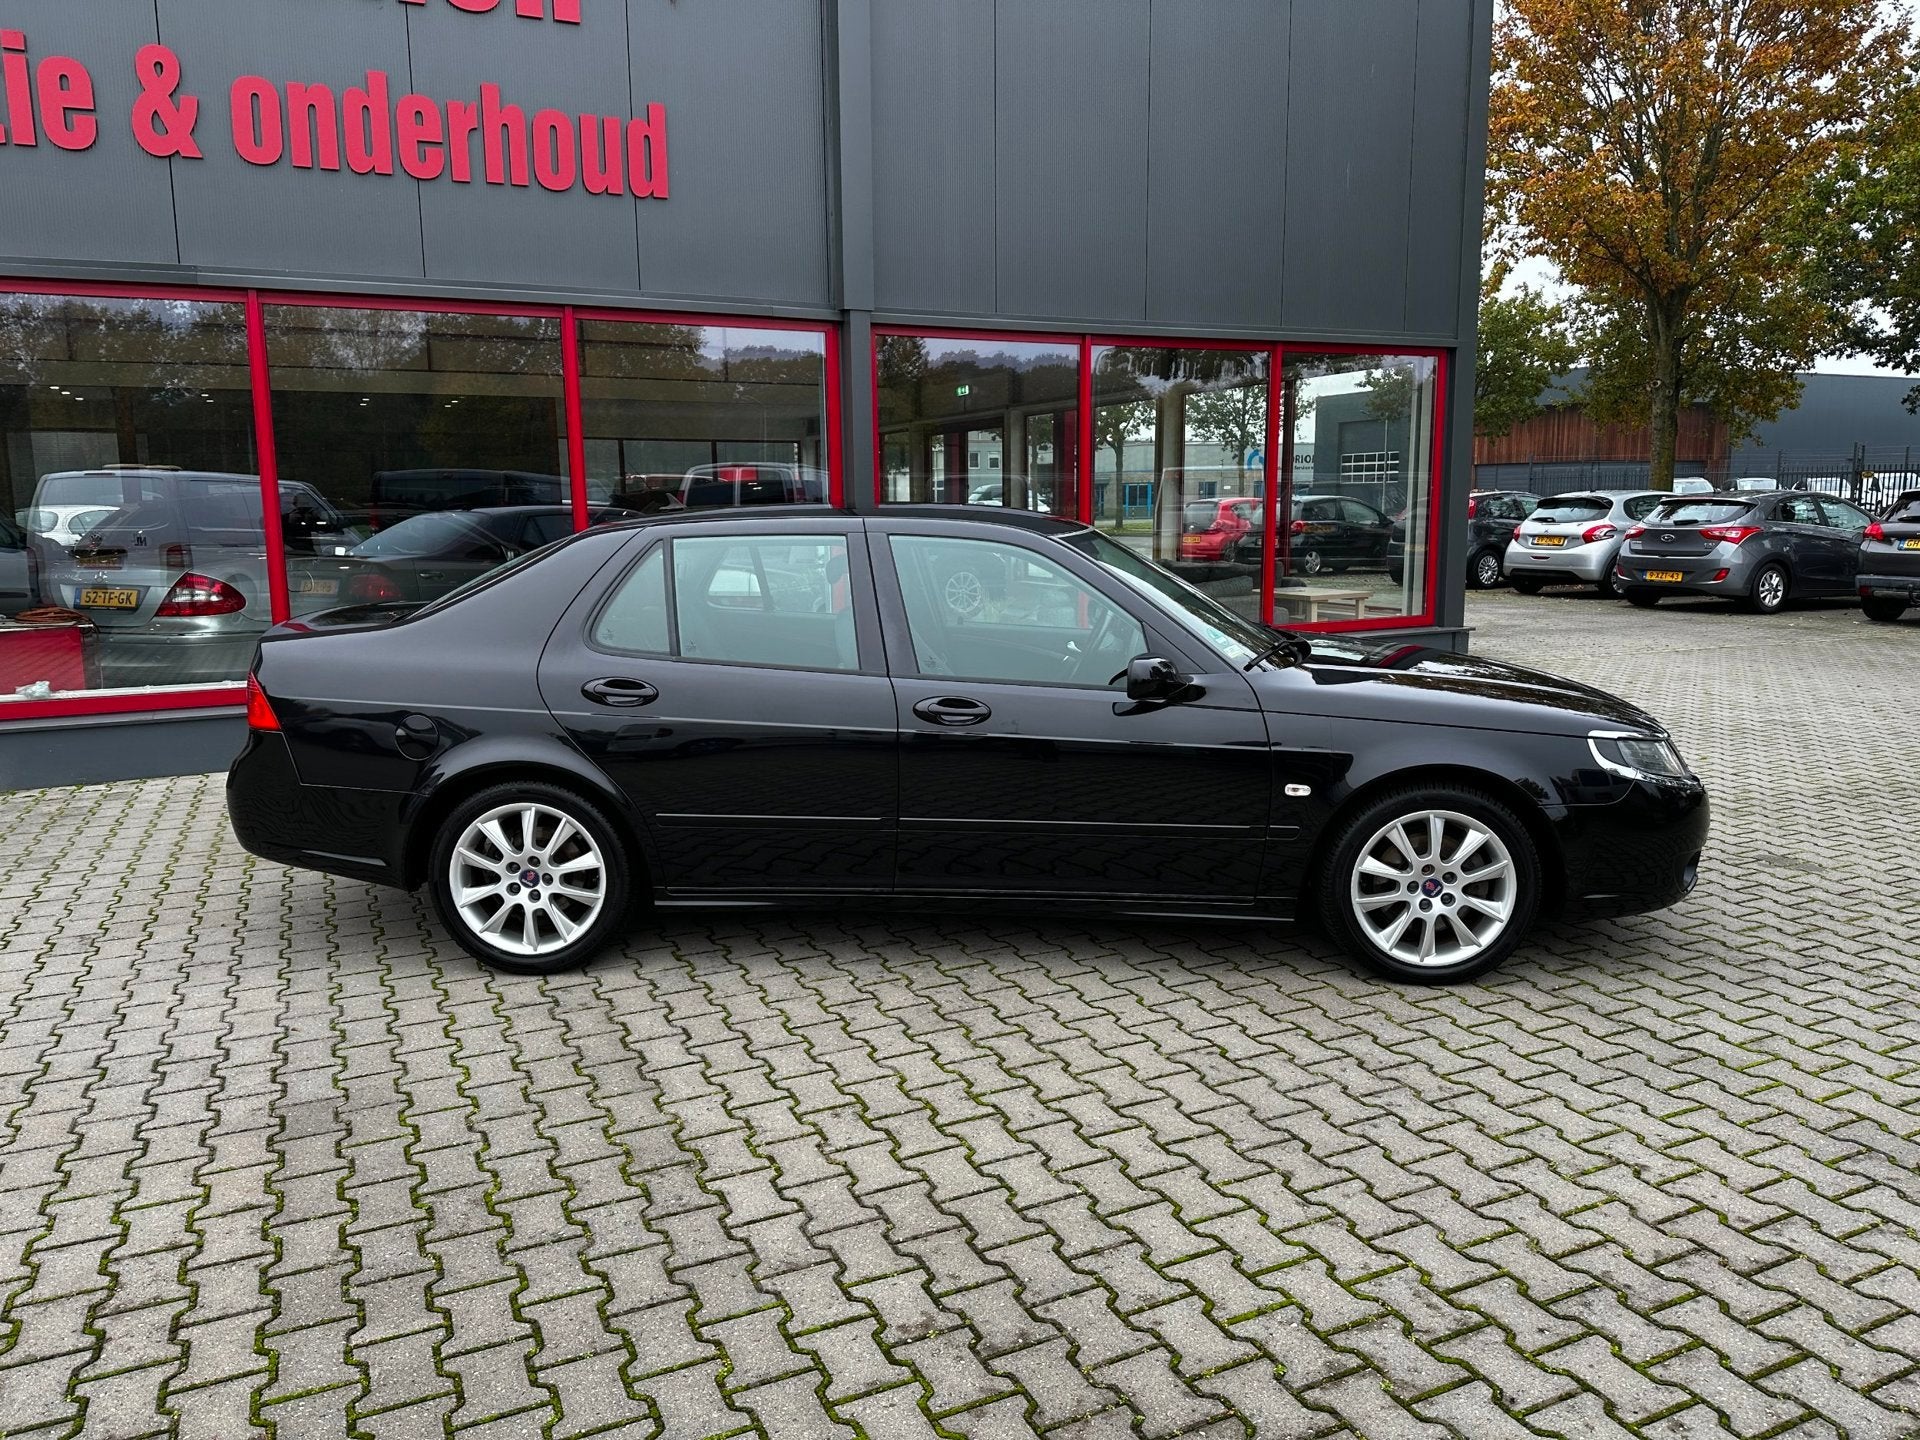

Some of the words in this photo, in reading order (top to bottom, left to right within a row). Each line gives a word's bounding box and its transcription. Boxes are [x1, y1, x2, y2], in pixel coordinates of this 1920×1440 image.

[0, 28, 97, 150] ie
[132, 44, 203, 159] &
[230, 70, 669, 199] onderhoud
[1293, 454, 1314, 463] RIO
[85, 590, 133, 605] 52-TF-GK
